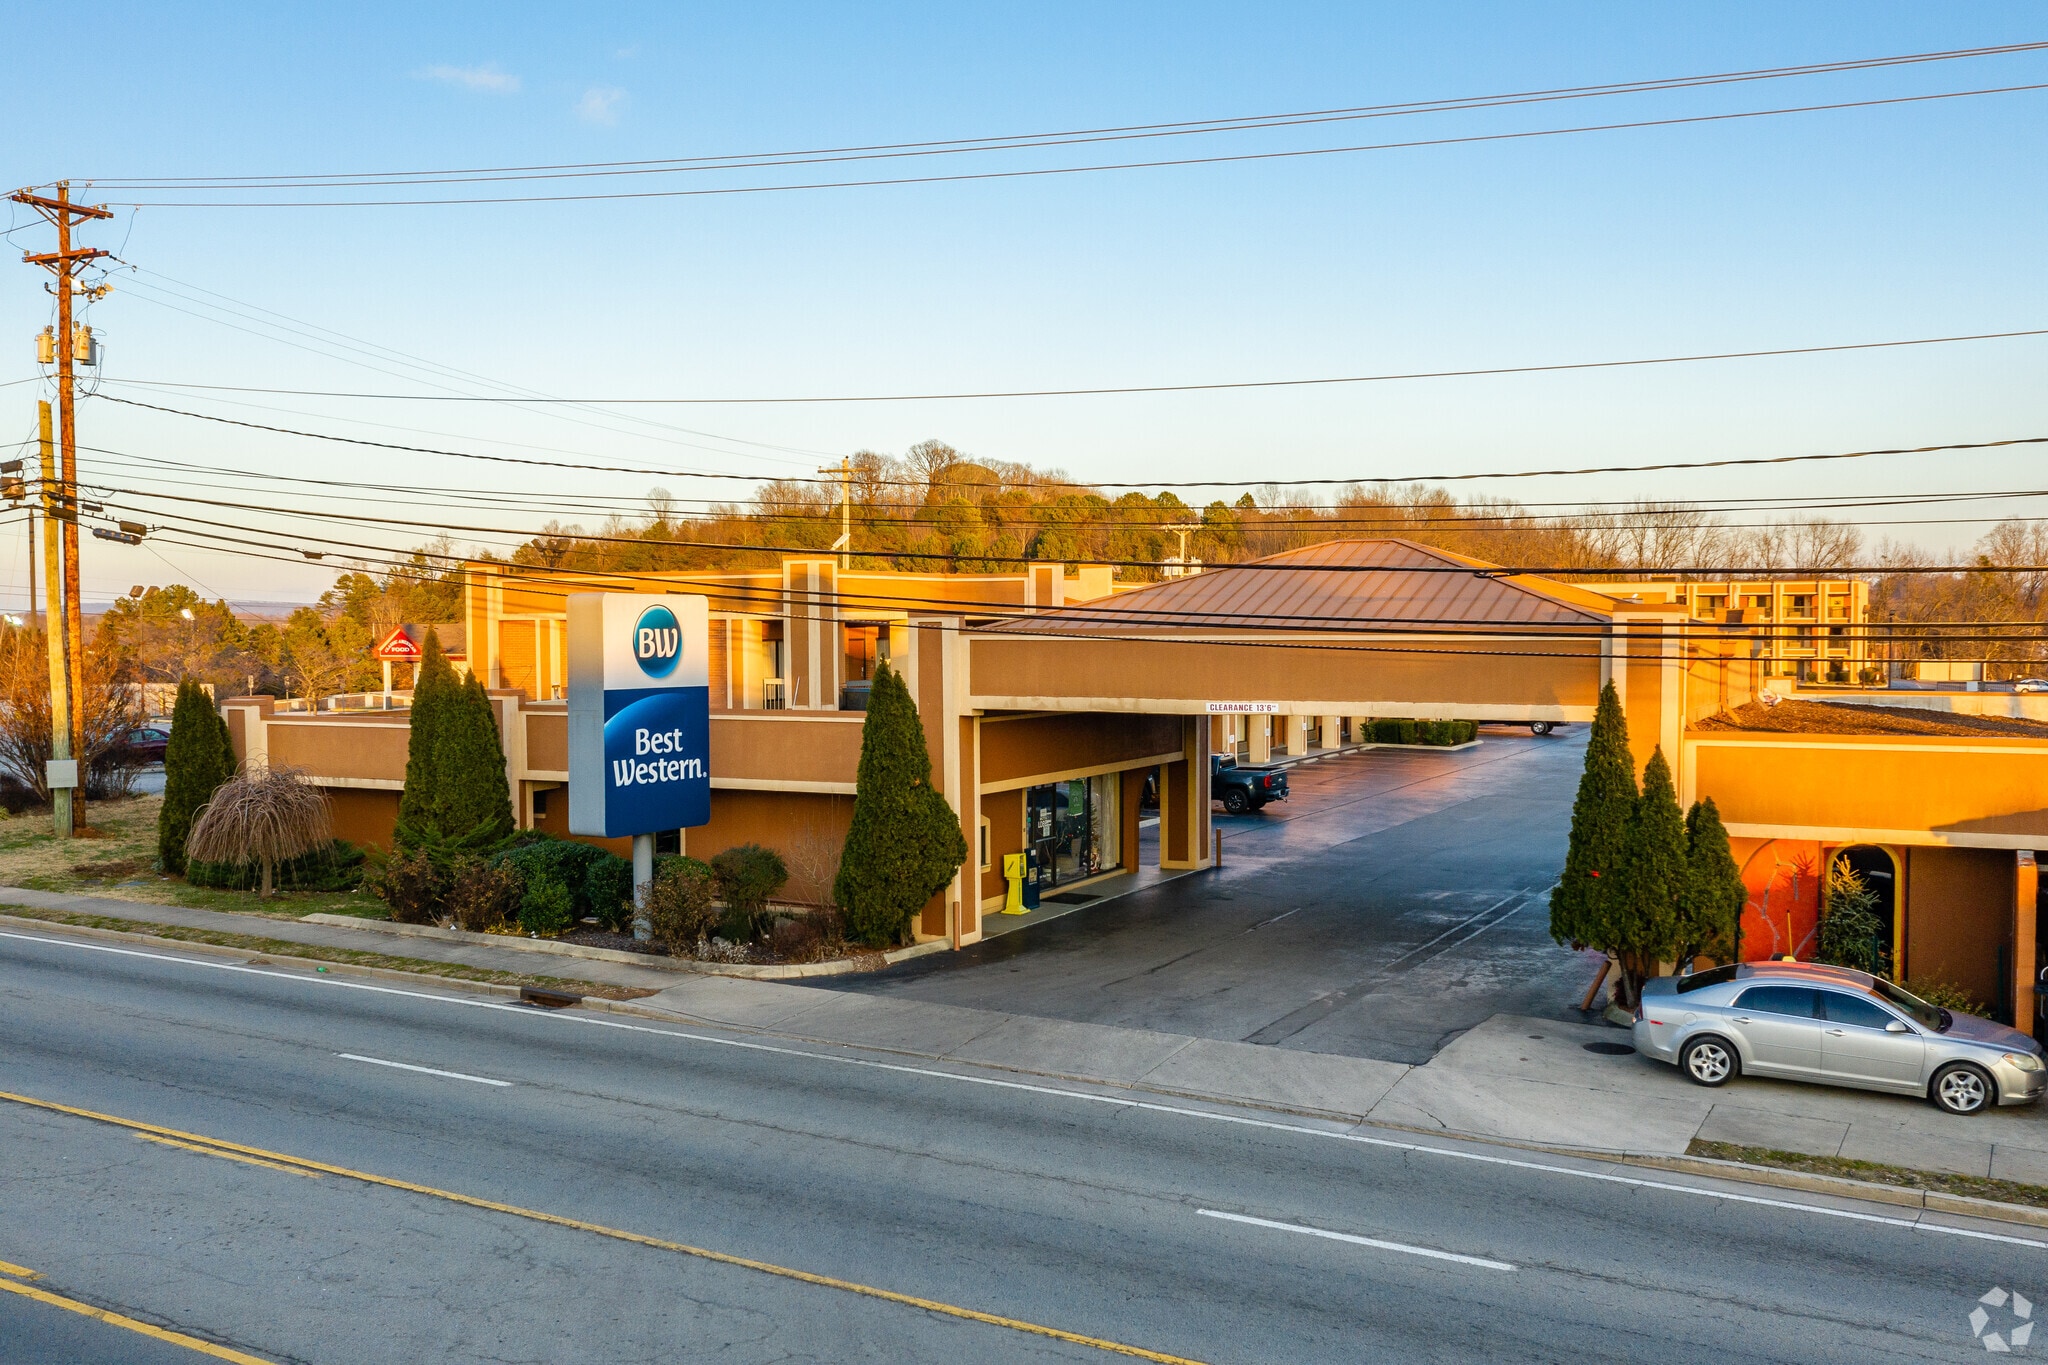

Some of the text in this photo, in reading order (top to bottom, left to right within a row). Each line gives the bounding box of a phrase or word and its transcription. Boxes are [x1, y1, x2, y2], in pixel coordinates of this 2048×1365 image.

[638, 628, 678, 659] BW
[1209, 703, 1253, 712] CLEARANCE
[635, 728, 683, 756] Best
